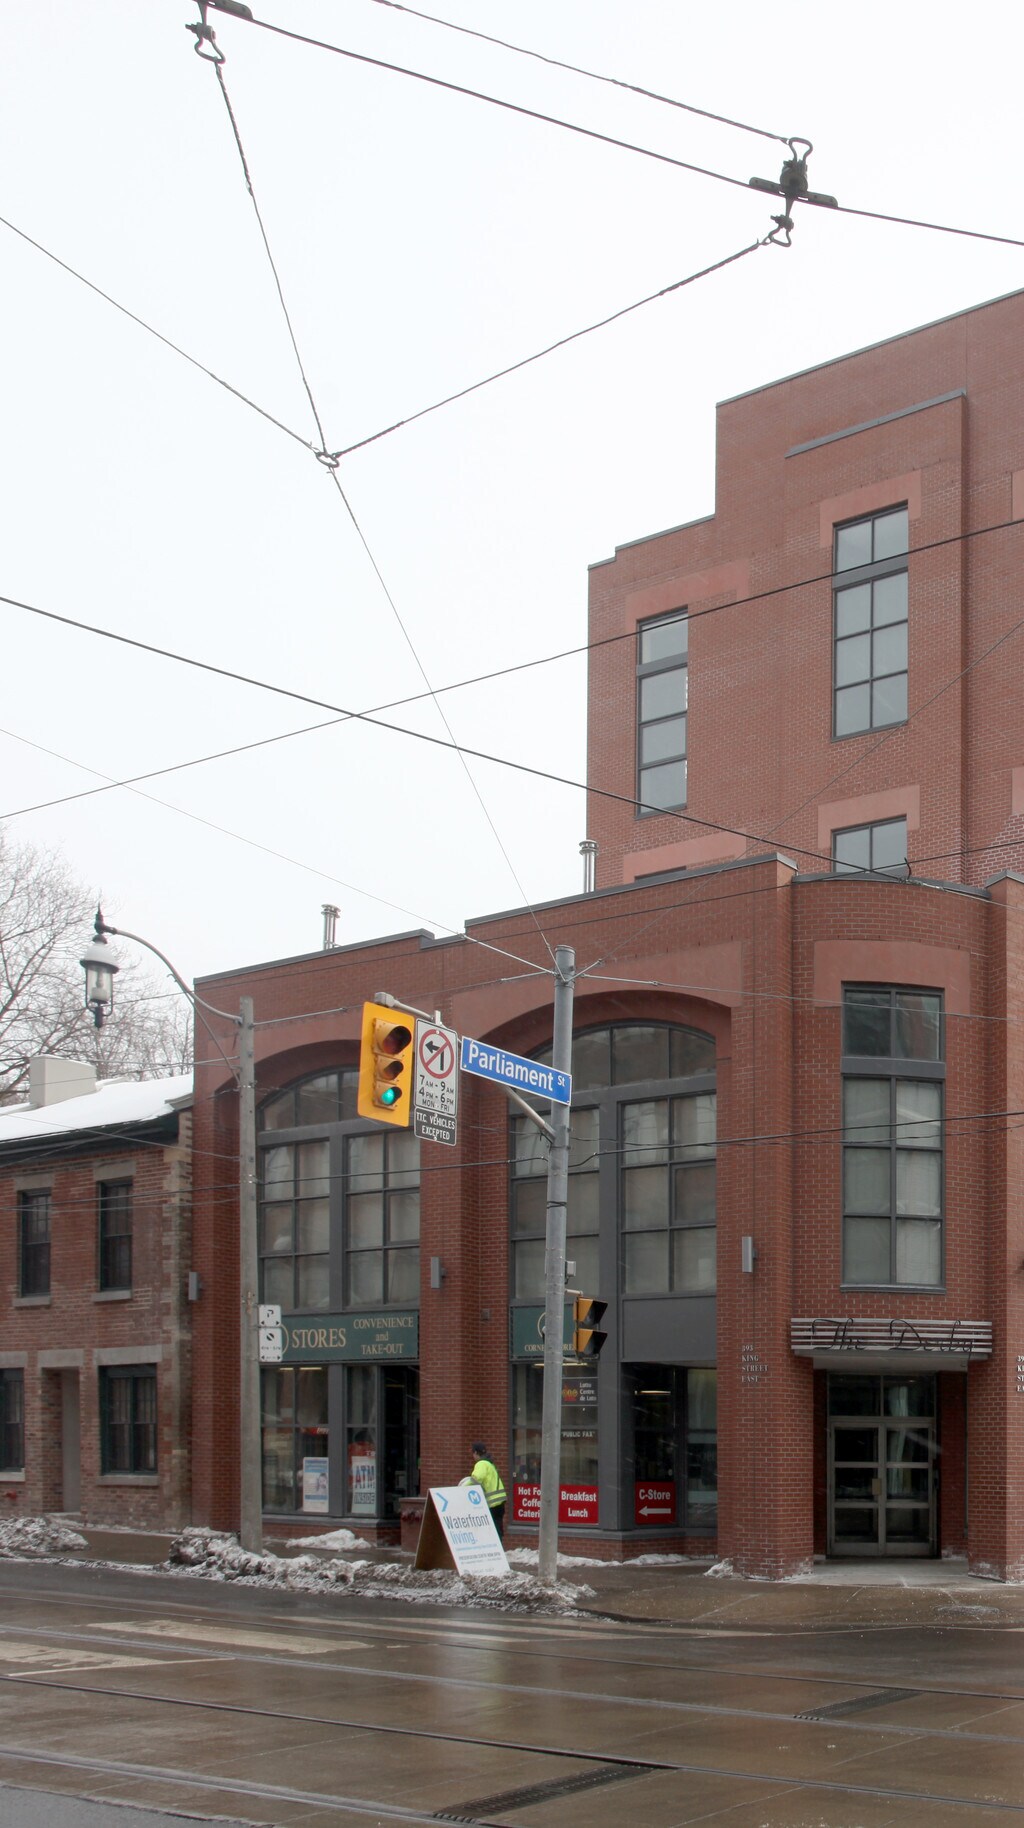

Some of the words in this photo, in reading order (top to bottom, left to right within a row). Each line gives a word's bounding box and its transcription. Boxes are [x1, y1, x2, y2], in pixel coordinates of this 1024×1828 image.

[469, 1043, 553, 1092] Parliament
[557, 1075, 566, 1087] St
[422, 1099, 435, 1108] MON
[440, 1103, 450, 1112] FRI
[429, 1115, 456, 1130] VEHICLES
[421, 1125, 451, 1140] EXCEPTED
[353, 1316, 414, 1329] CONVENIENCE
[292, 1328, 347, 1348] STORES
[375, 1331, 389, 1342] and
[812, 1318, 867, 1350] The
[361, 1343, 404, 1355] TAKE-OUT
[741, 1354, 759, 1362] KING
[741, 1364, 769, 1372] STREET
[741, 1375, 759, 1383] EAST
[355, 1465, 375, 1489] ATM
[518, 1487, 531, 1496] Hot
[561, 1491, 597, 1502] Breakfast
[639, 1489, 671, 1500] C-Store
[354, 1492, 375, 1505] INSIDE
[568, 1508, 588, 1518] Lunch
[443, 1513, 490, 1530] Waterfront
[450, 1531, 478, 1545] living.
